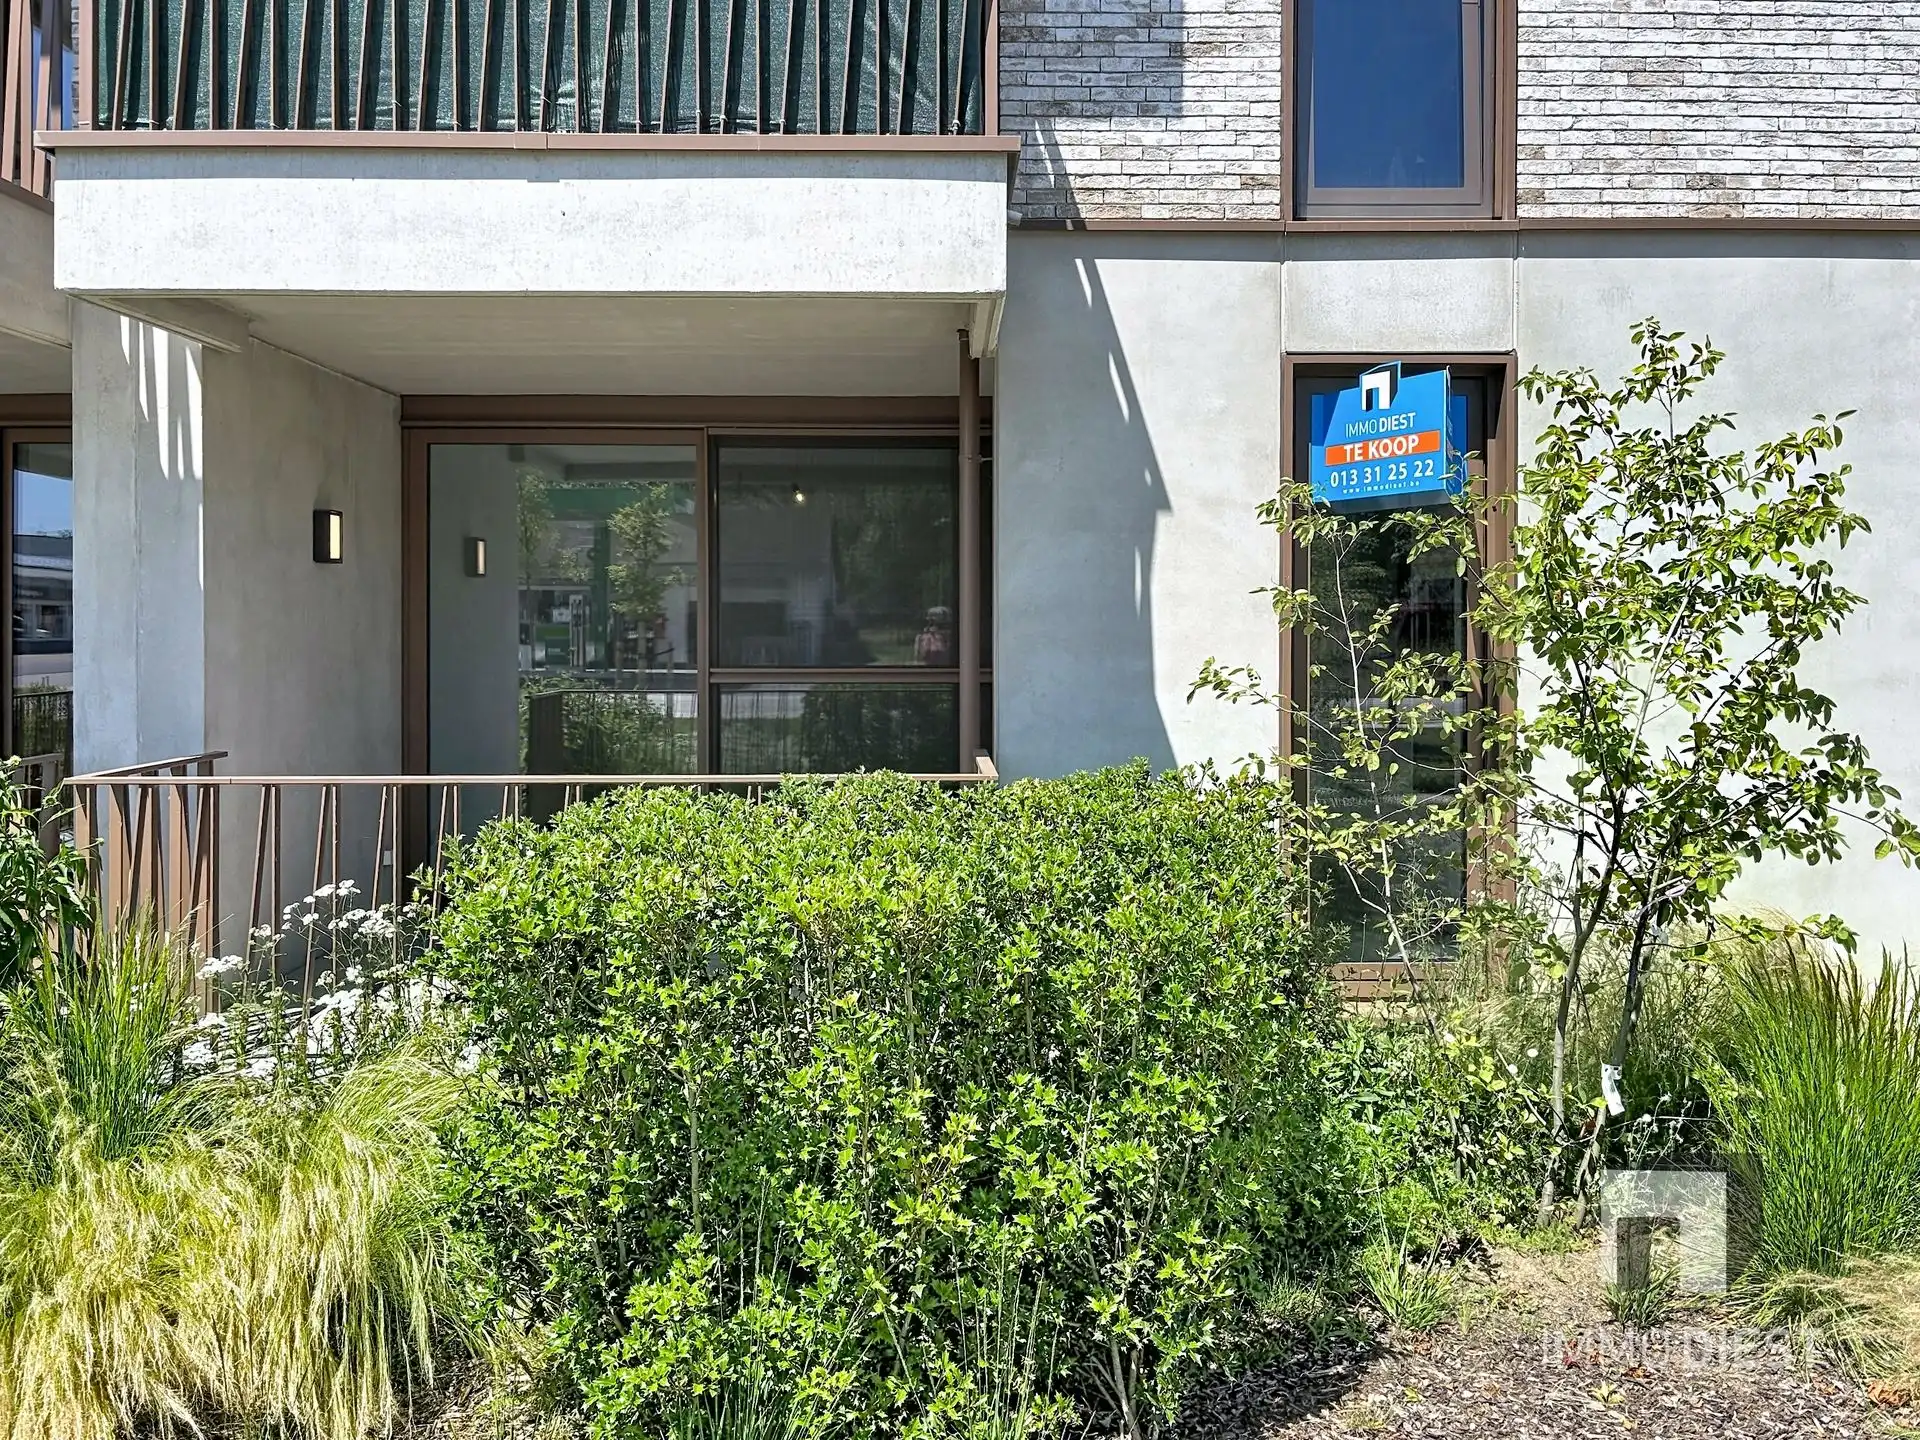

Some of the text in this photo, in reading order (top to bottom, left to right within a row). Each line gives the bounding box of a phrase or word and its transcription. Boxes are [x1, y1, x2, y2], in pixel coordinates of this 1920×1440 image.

[1345, 412, 1416, 438] IMMO DIEST
[1343, 435, 1420, 463] TE KOOP
[1330, 459, 1434, 488] 013 31 25 22
